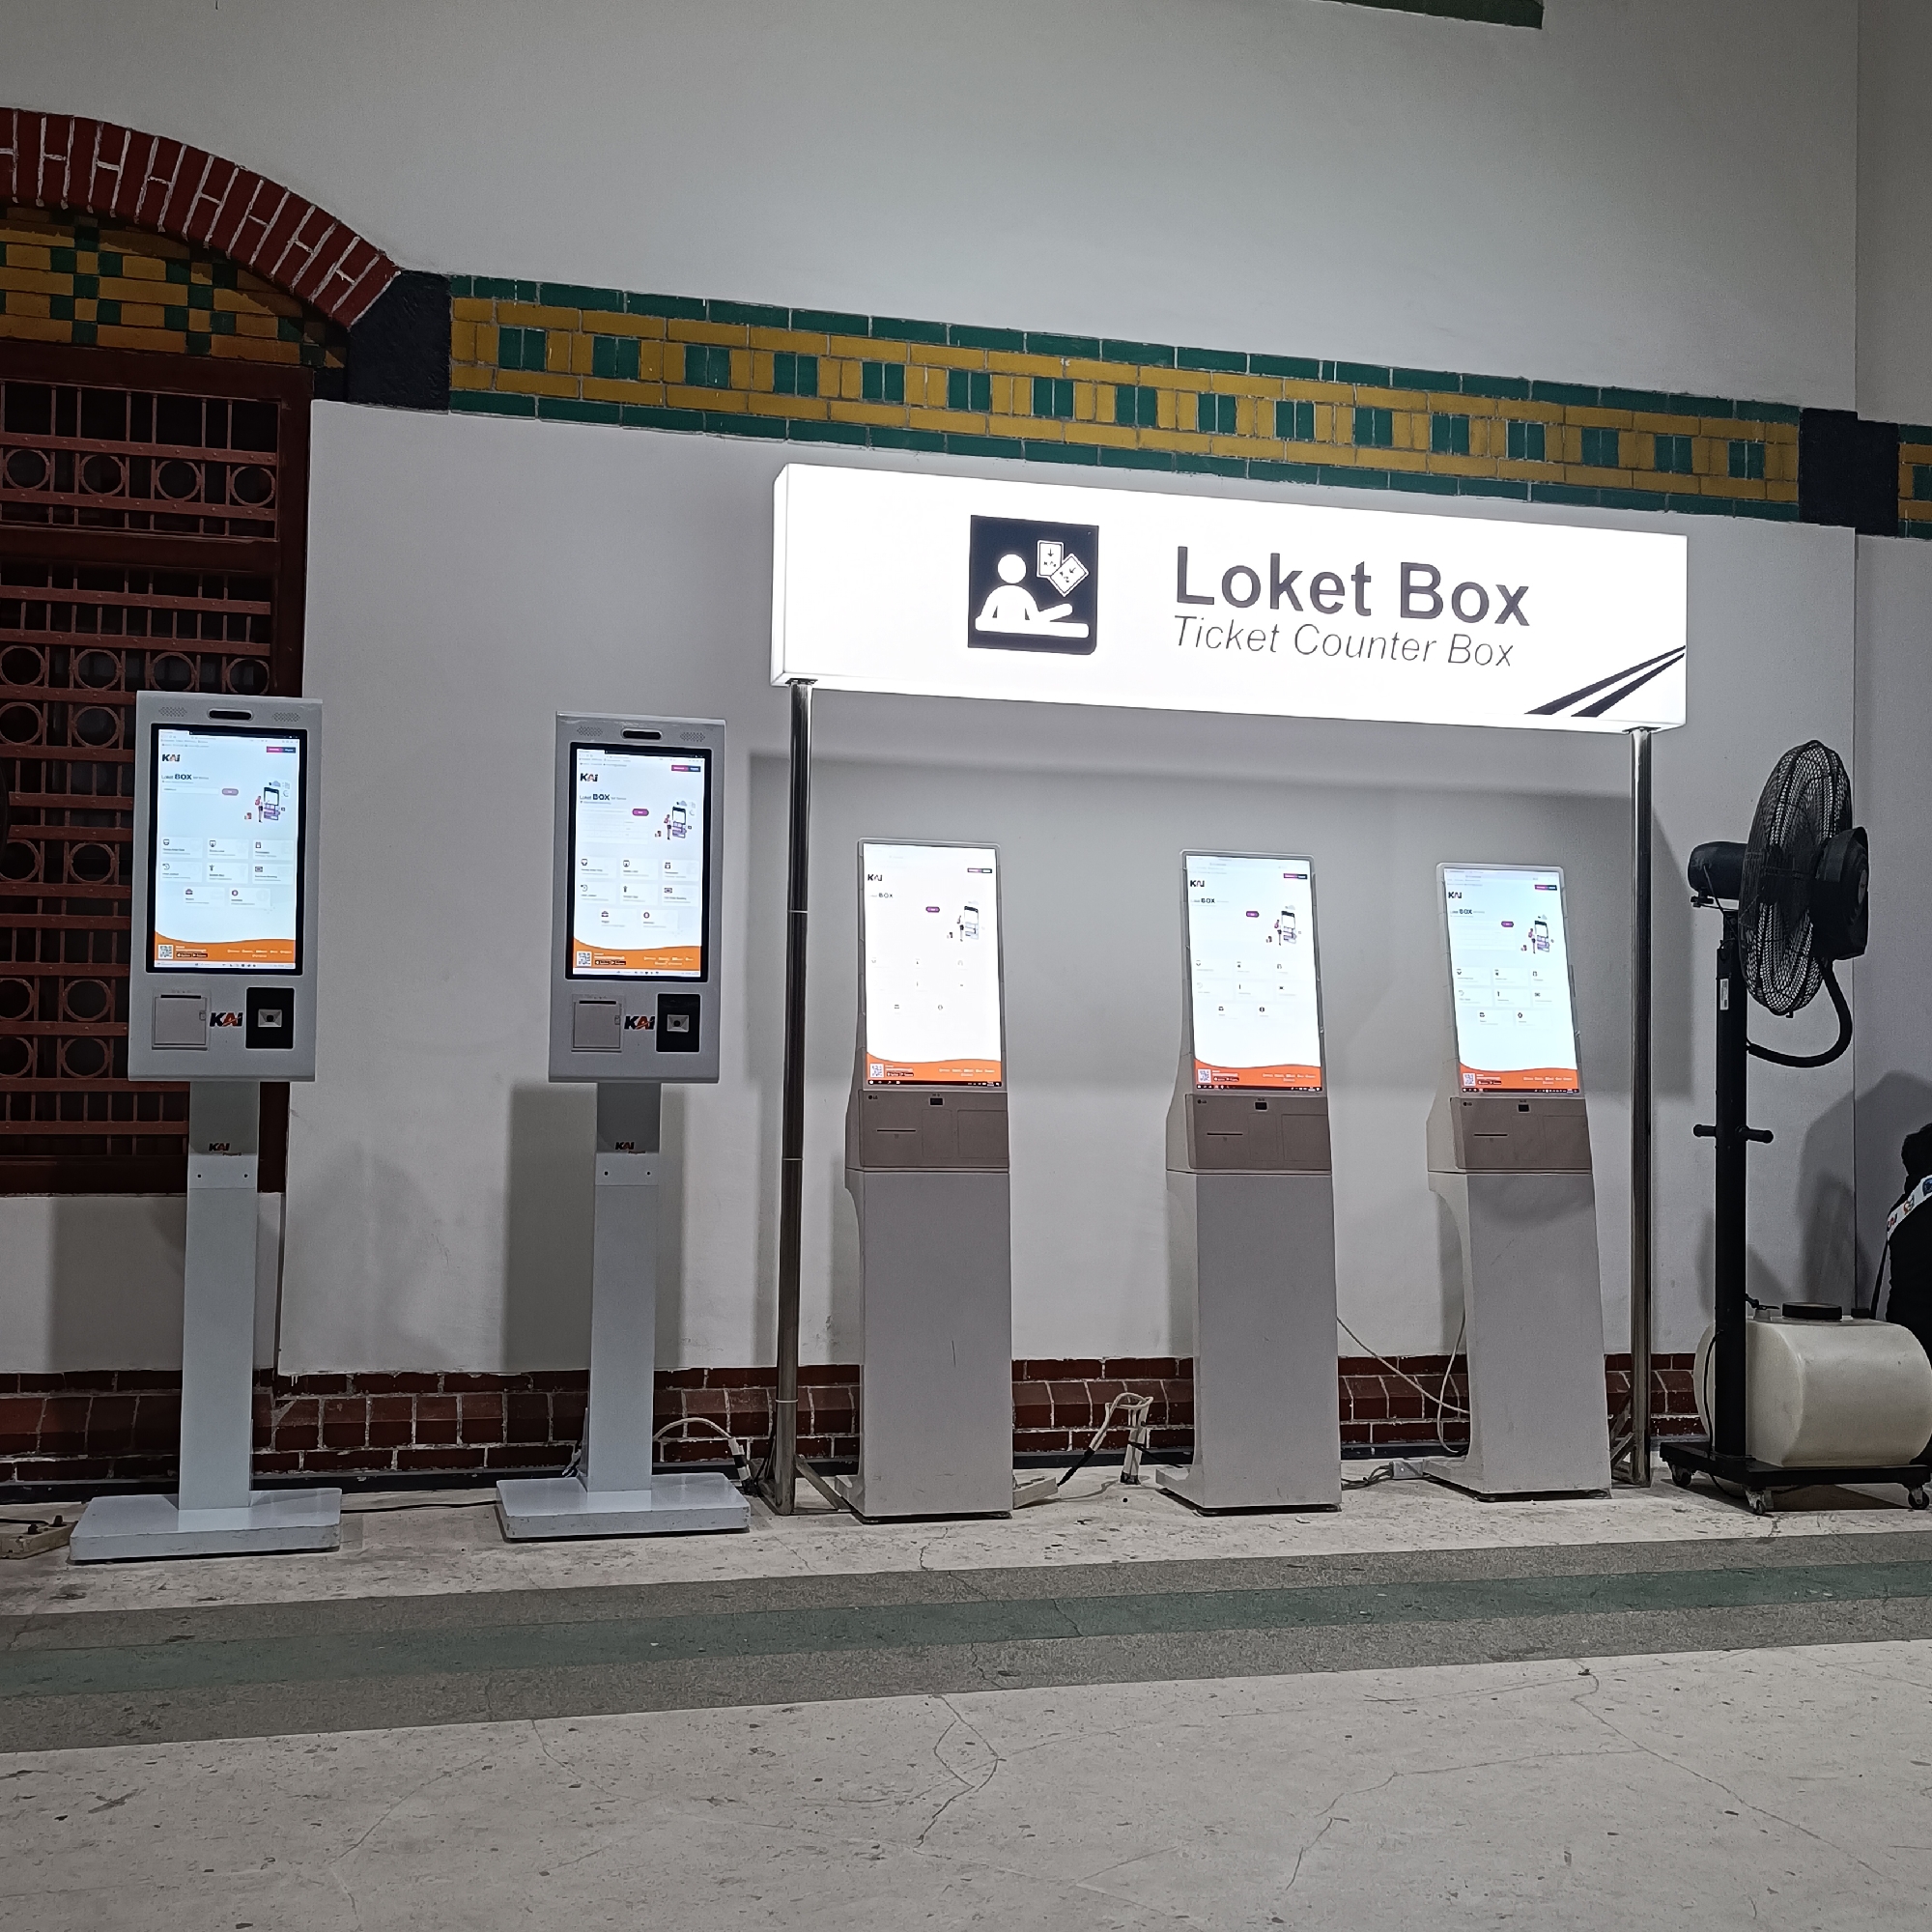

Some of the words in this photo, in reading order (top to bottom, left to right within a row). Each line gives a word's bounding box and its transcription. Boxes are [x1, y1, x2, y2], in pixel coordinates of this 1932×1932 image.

[1177, 546, 1372, 617] Loket
[1400, 561, 1530, 627] Box
[1175, 614, 1280, 653] Ticket
[1294, 623, 1437, 663] Counter
[1448, 633, 1514, 667] Box
[209, 1012, 243, 1027] KAI
[624, 1015, 656, 1030] KAI
[209, 1143, 230, 1151] KAI
[614, 1142, 635, 1151] KAI
